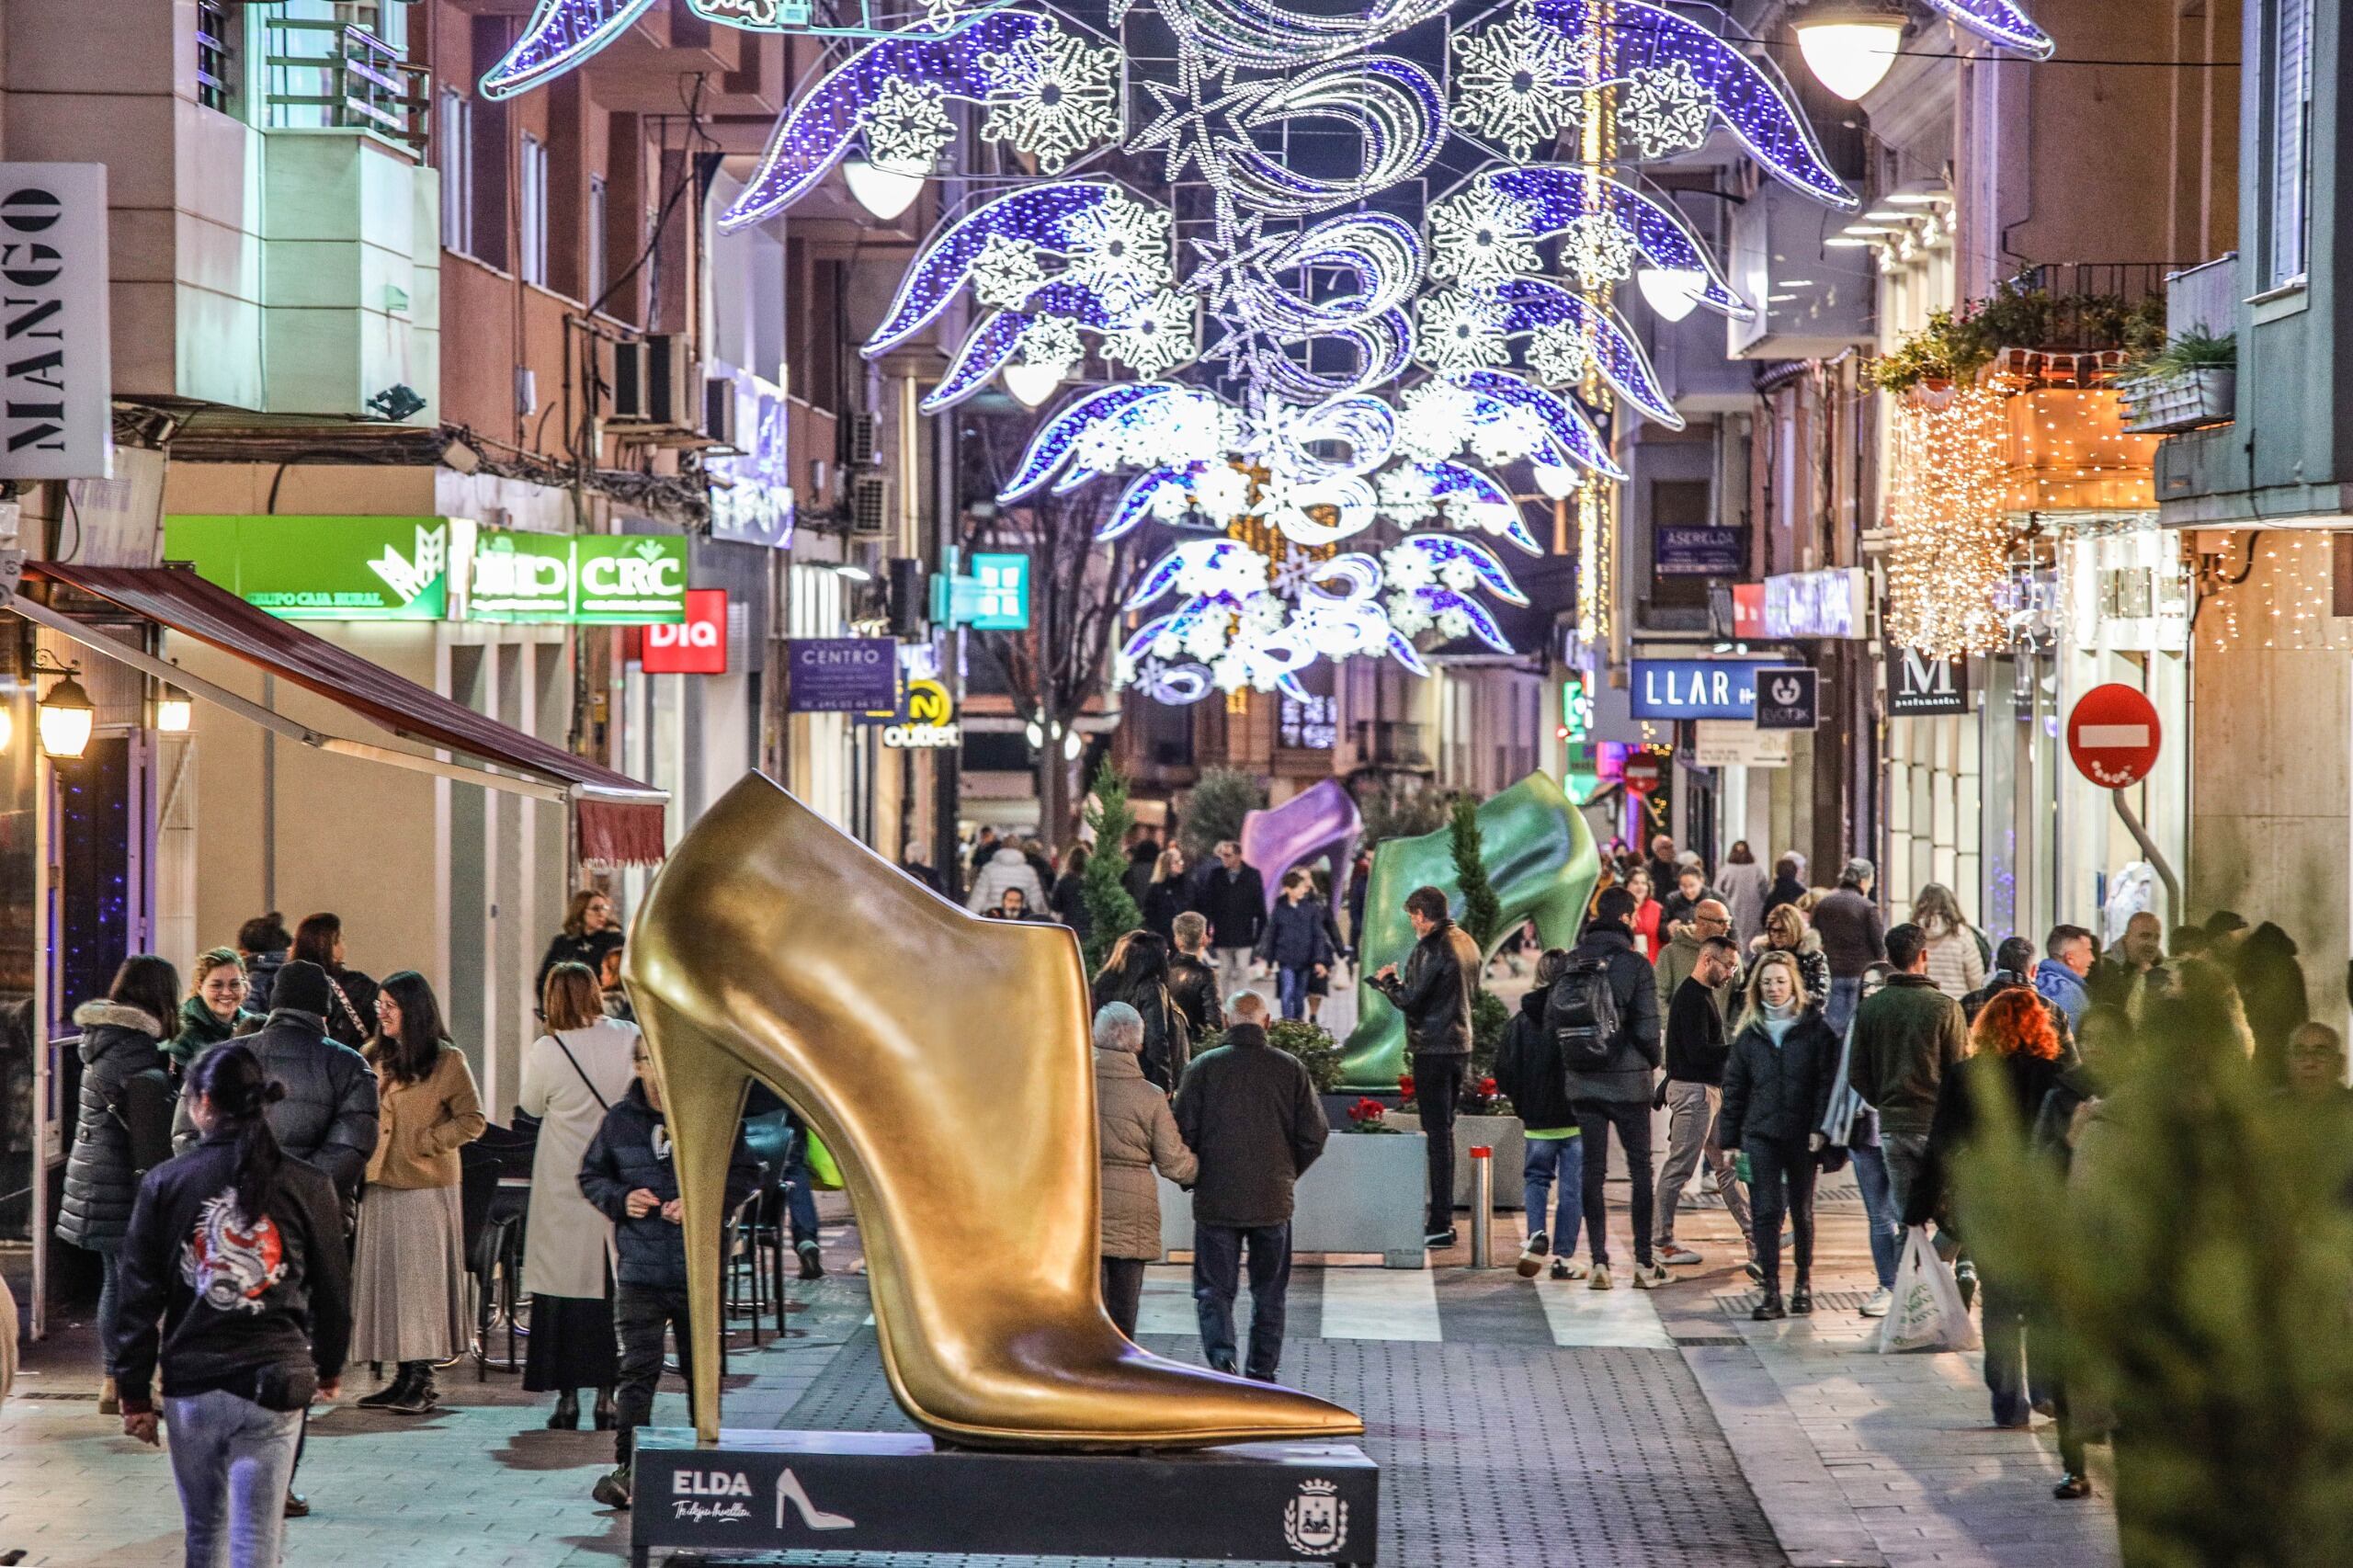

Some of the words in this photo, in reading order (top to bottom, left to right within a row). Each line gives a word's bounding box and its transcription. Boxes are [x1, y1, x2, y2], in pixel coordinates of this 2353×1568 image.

[1, 188, 64, 452] MANGO
[581, 557, 683, 596] CRC
[801, 650, 880, 665] CENTRO
[1899, 645, 1957, 696] M
[1646, 670, 1729, 705] LLAR
[883, 723, 961, 748] outlet
[673, 1471, 753, 1497] ELDA
